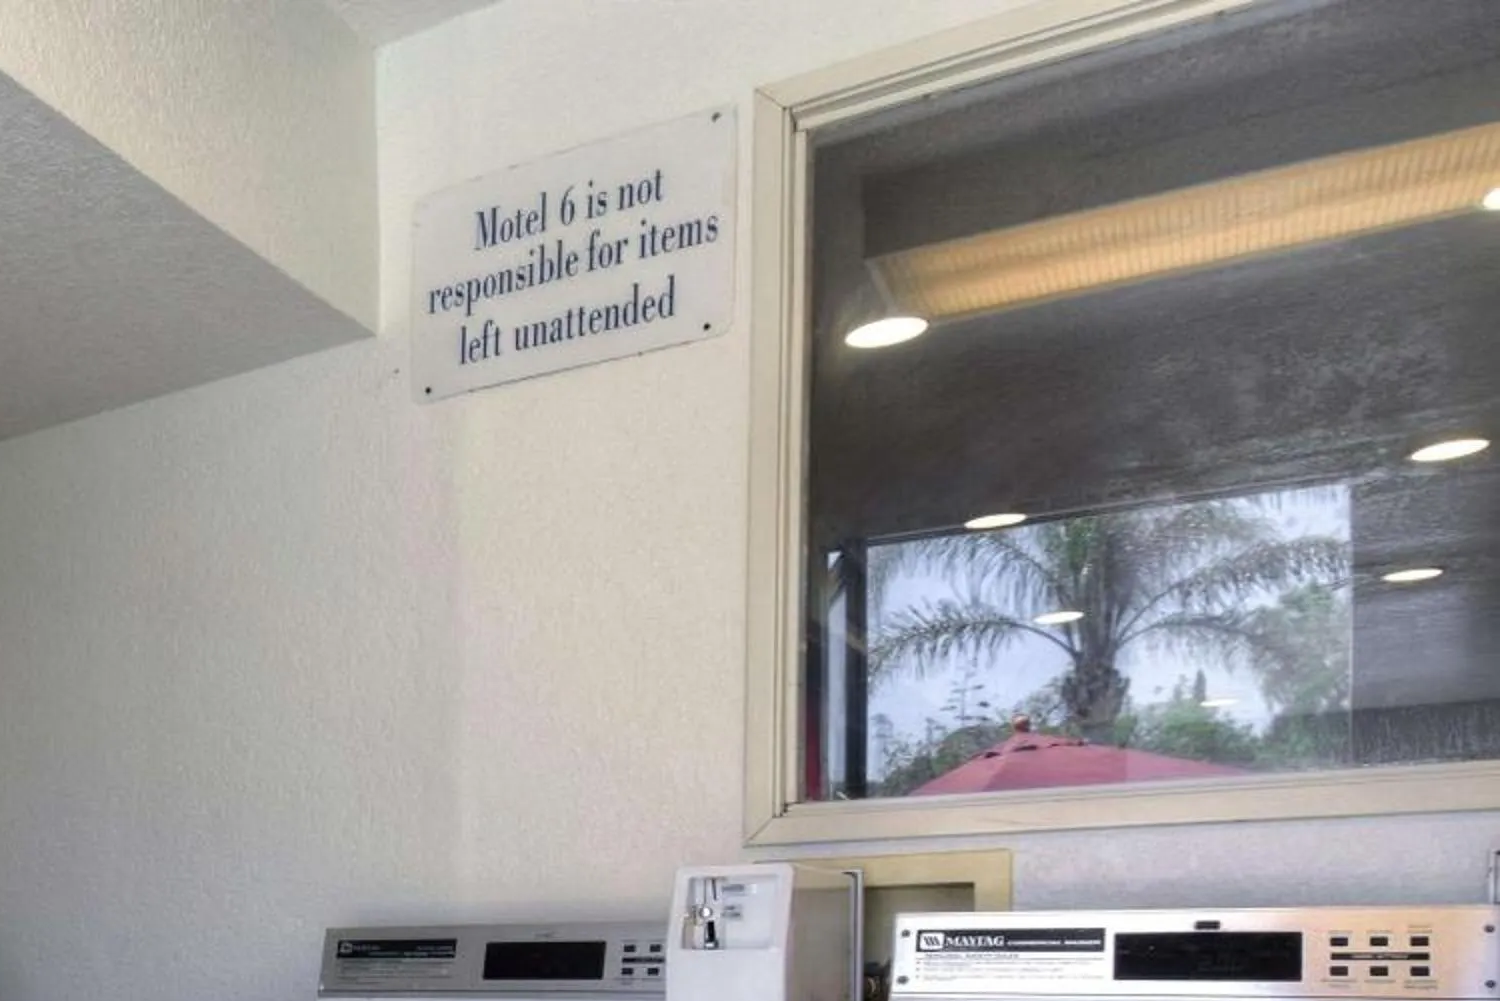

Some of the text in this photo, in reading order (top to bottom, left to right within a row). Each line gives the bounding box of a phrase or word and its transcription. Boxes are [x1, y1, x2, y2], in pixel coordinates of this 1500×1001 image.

[474, 169, 664, 250] Motel 6 is not
[429, 214, 719, 316] responsible for items
[460, 274, 676, 365] left unattended
